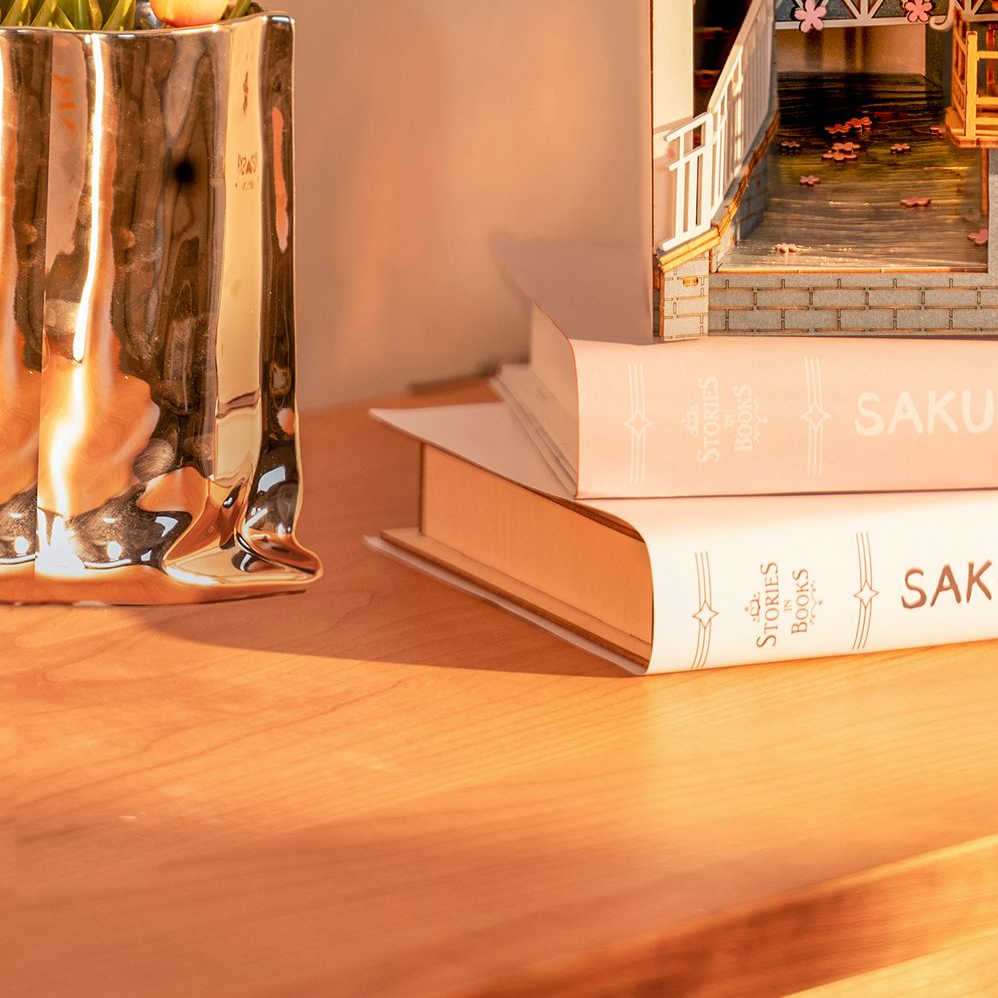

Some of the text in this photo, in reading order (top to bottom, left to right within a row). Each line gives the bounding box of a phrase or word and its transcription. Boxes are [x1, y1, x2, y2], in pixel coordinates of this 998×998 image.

[696, 376, 720, 463] STORIES
[733, 385, 753, 451] BOOKS
[756, 562, 780, 648] STORIES
[783, 599, 792, 612] IN
[791, 568, 810, 635] BOOKS
